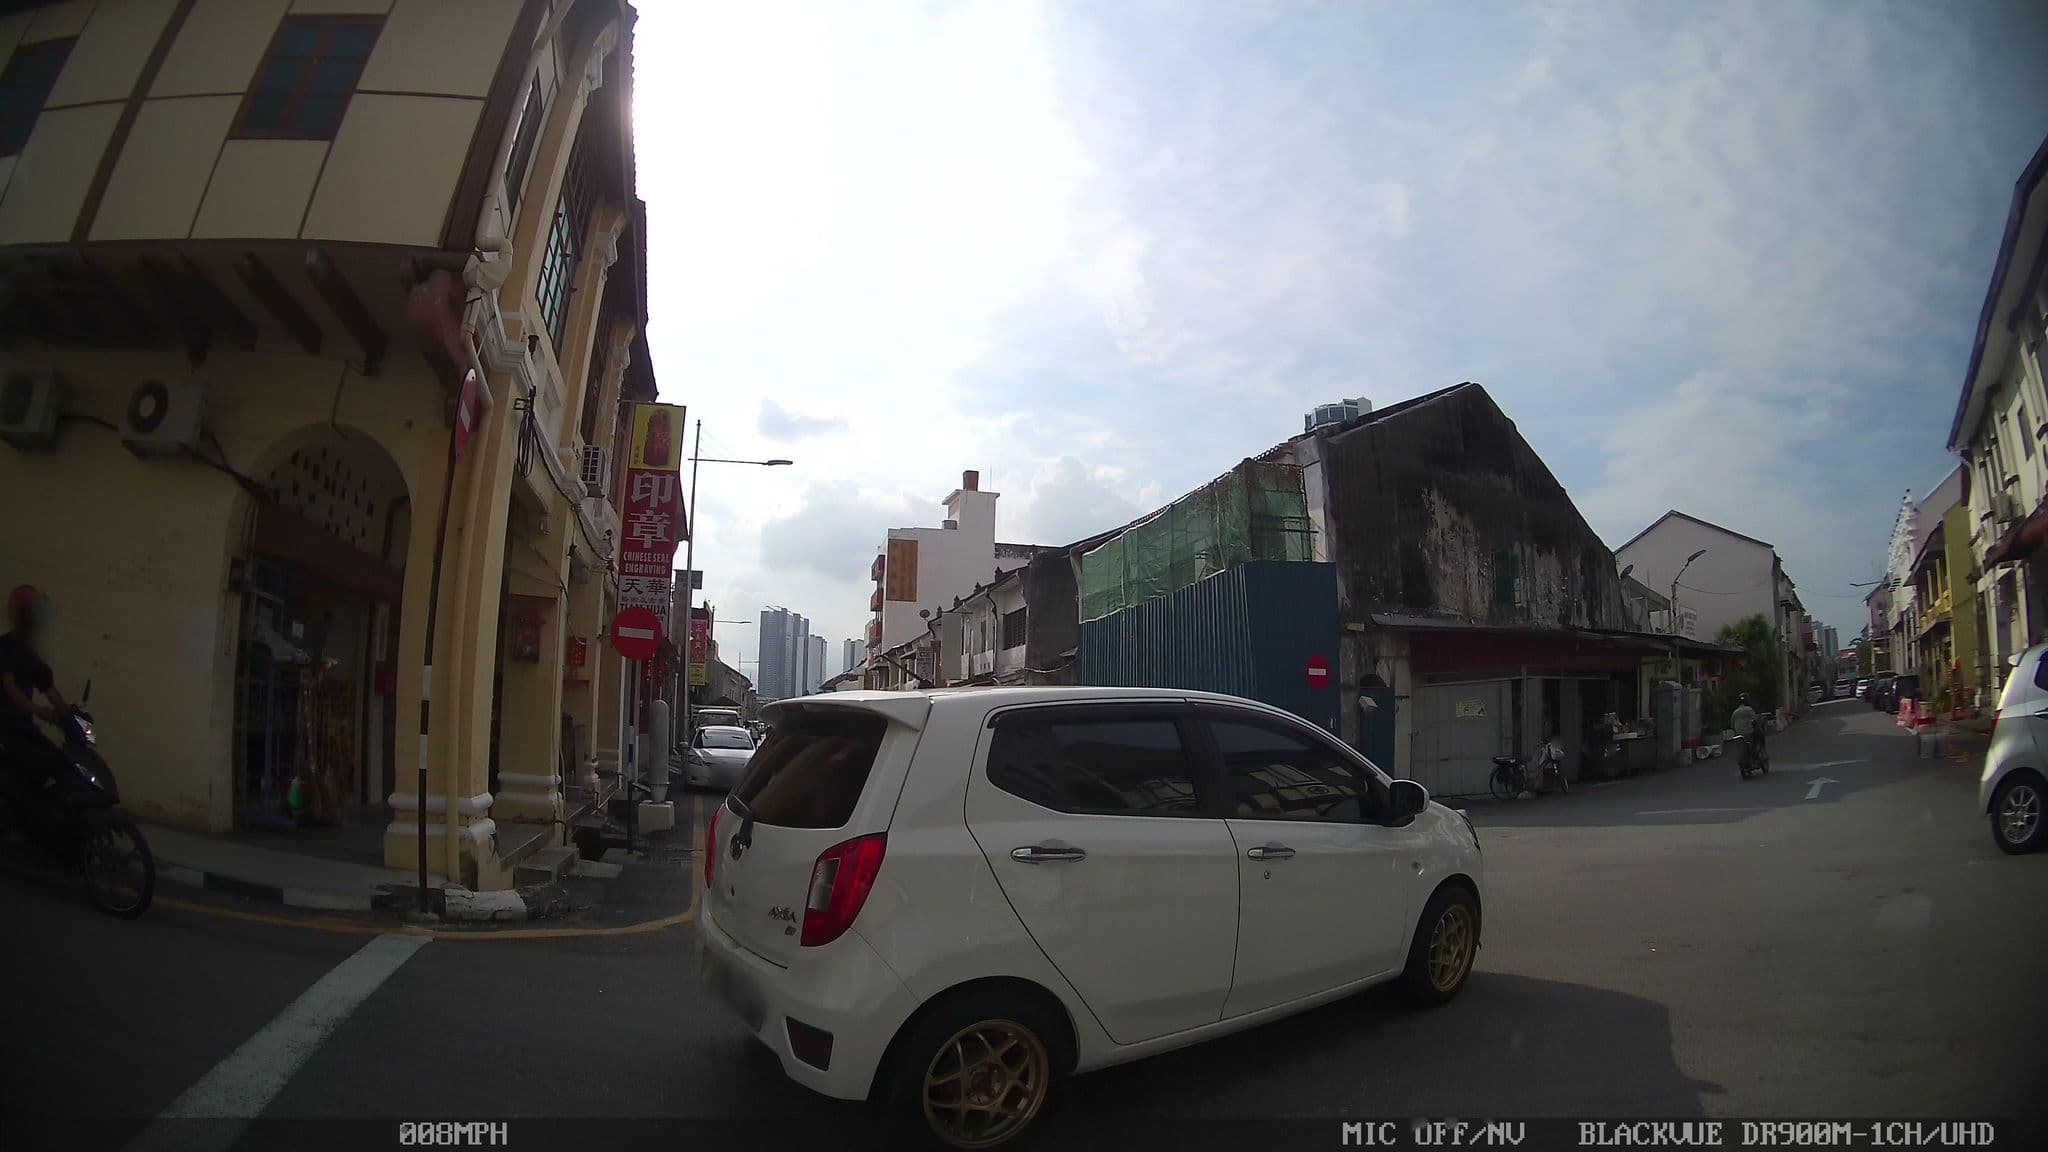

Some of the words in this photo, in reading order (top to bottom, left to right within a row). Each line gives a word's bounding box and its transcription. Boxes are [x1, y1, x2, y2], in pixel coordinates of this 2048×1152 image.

[625, 472, 676, 549] 印章
[623, 551, 652, 562] CHINESE
[653, 553, 670, 563] SEAL
[625, 562, 666, 574] ENGRAVING
[622, 578, 667, 595] 天華
